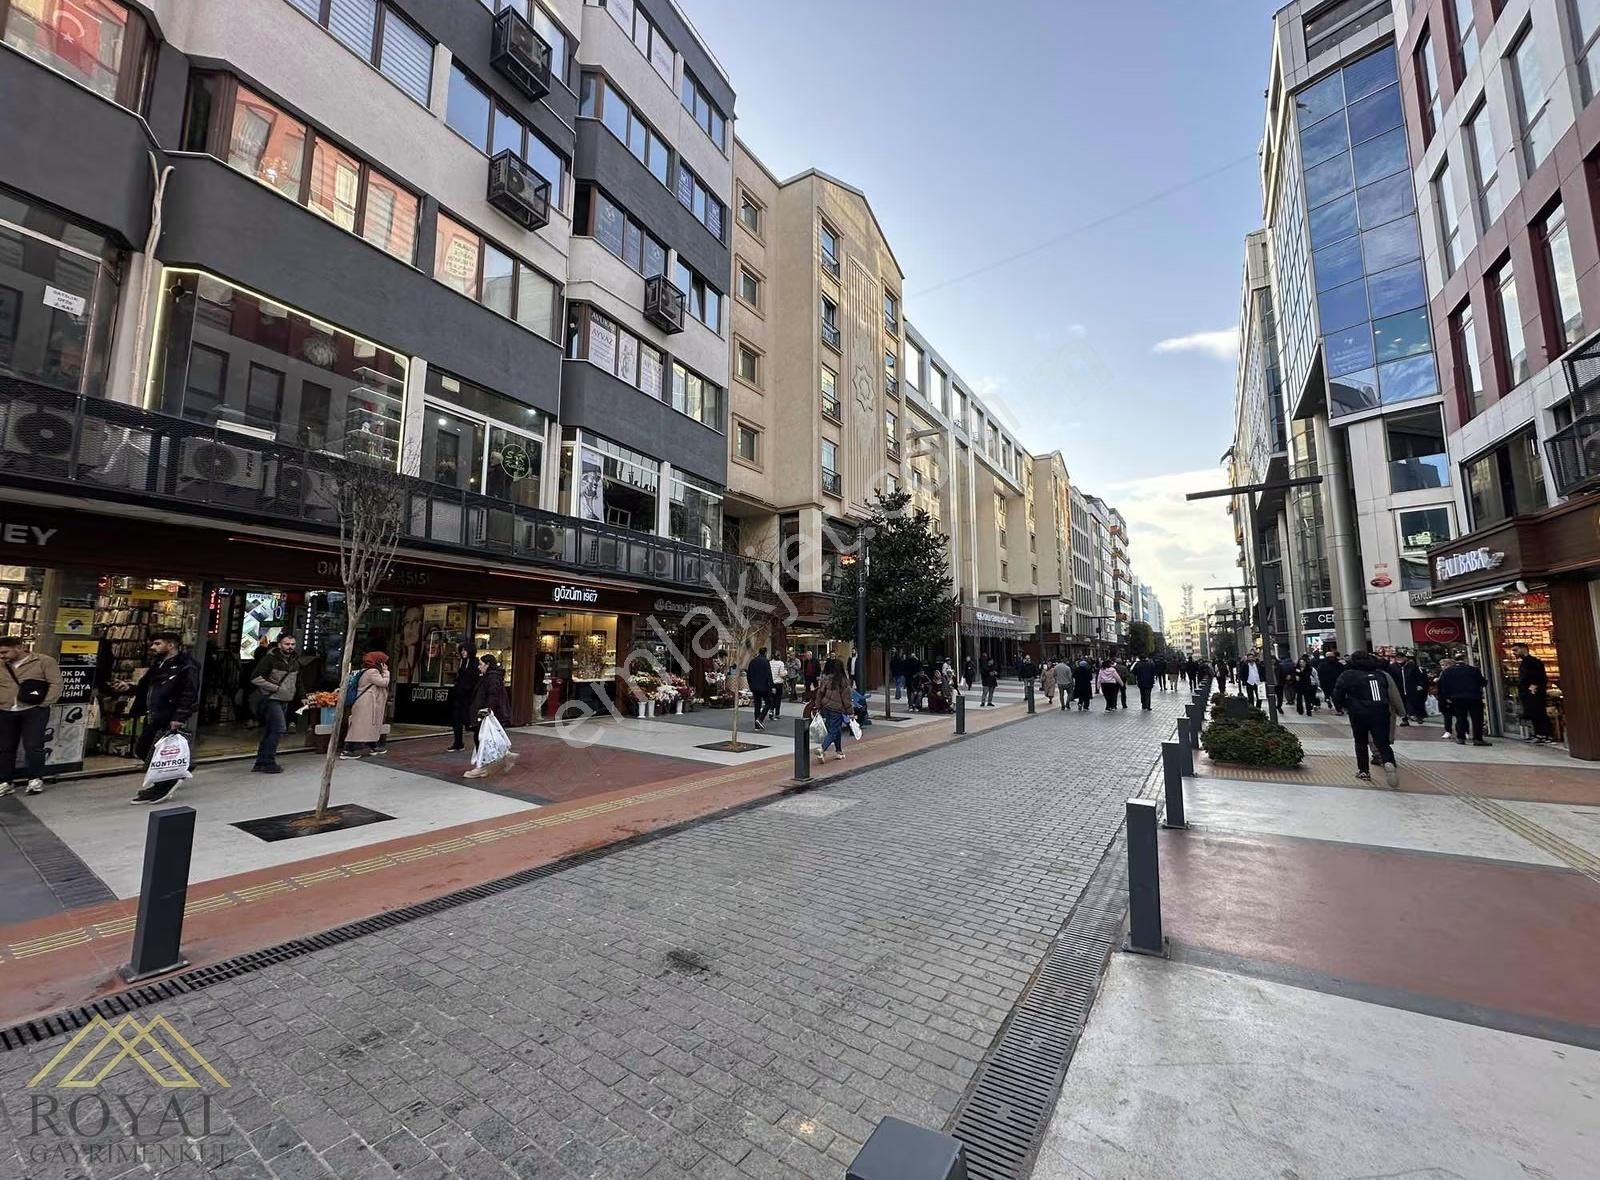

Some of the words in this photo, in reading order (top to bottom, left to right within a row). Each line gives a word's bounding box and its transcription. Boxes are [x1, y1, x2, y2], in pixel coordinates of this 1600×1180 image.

[0, 522, 58, 546] EY
[583, 591, 598, 603] 1967
[1317, 613, 1335, 623] CE
[435, 689, 448, 701] 1967
[150, 758, 187, 768] KONTROL
